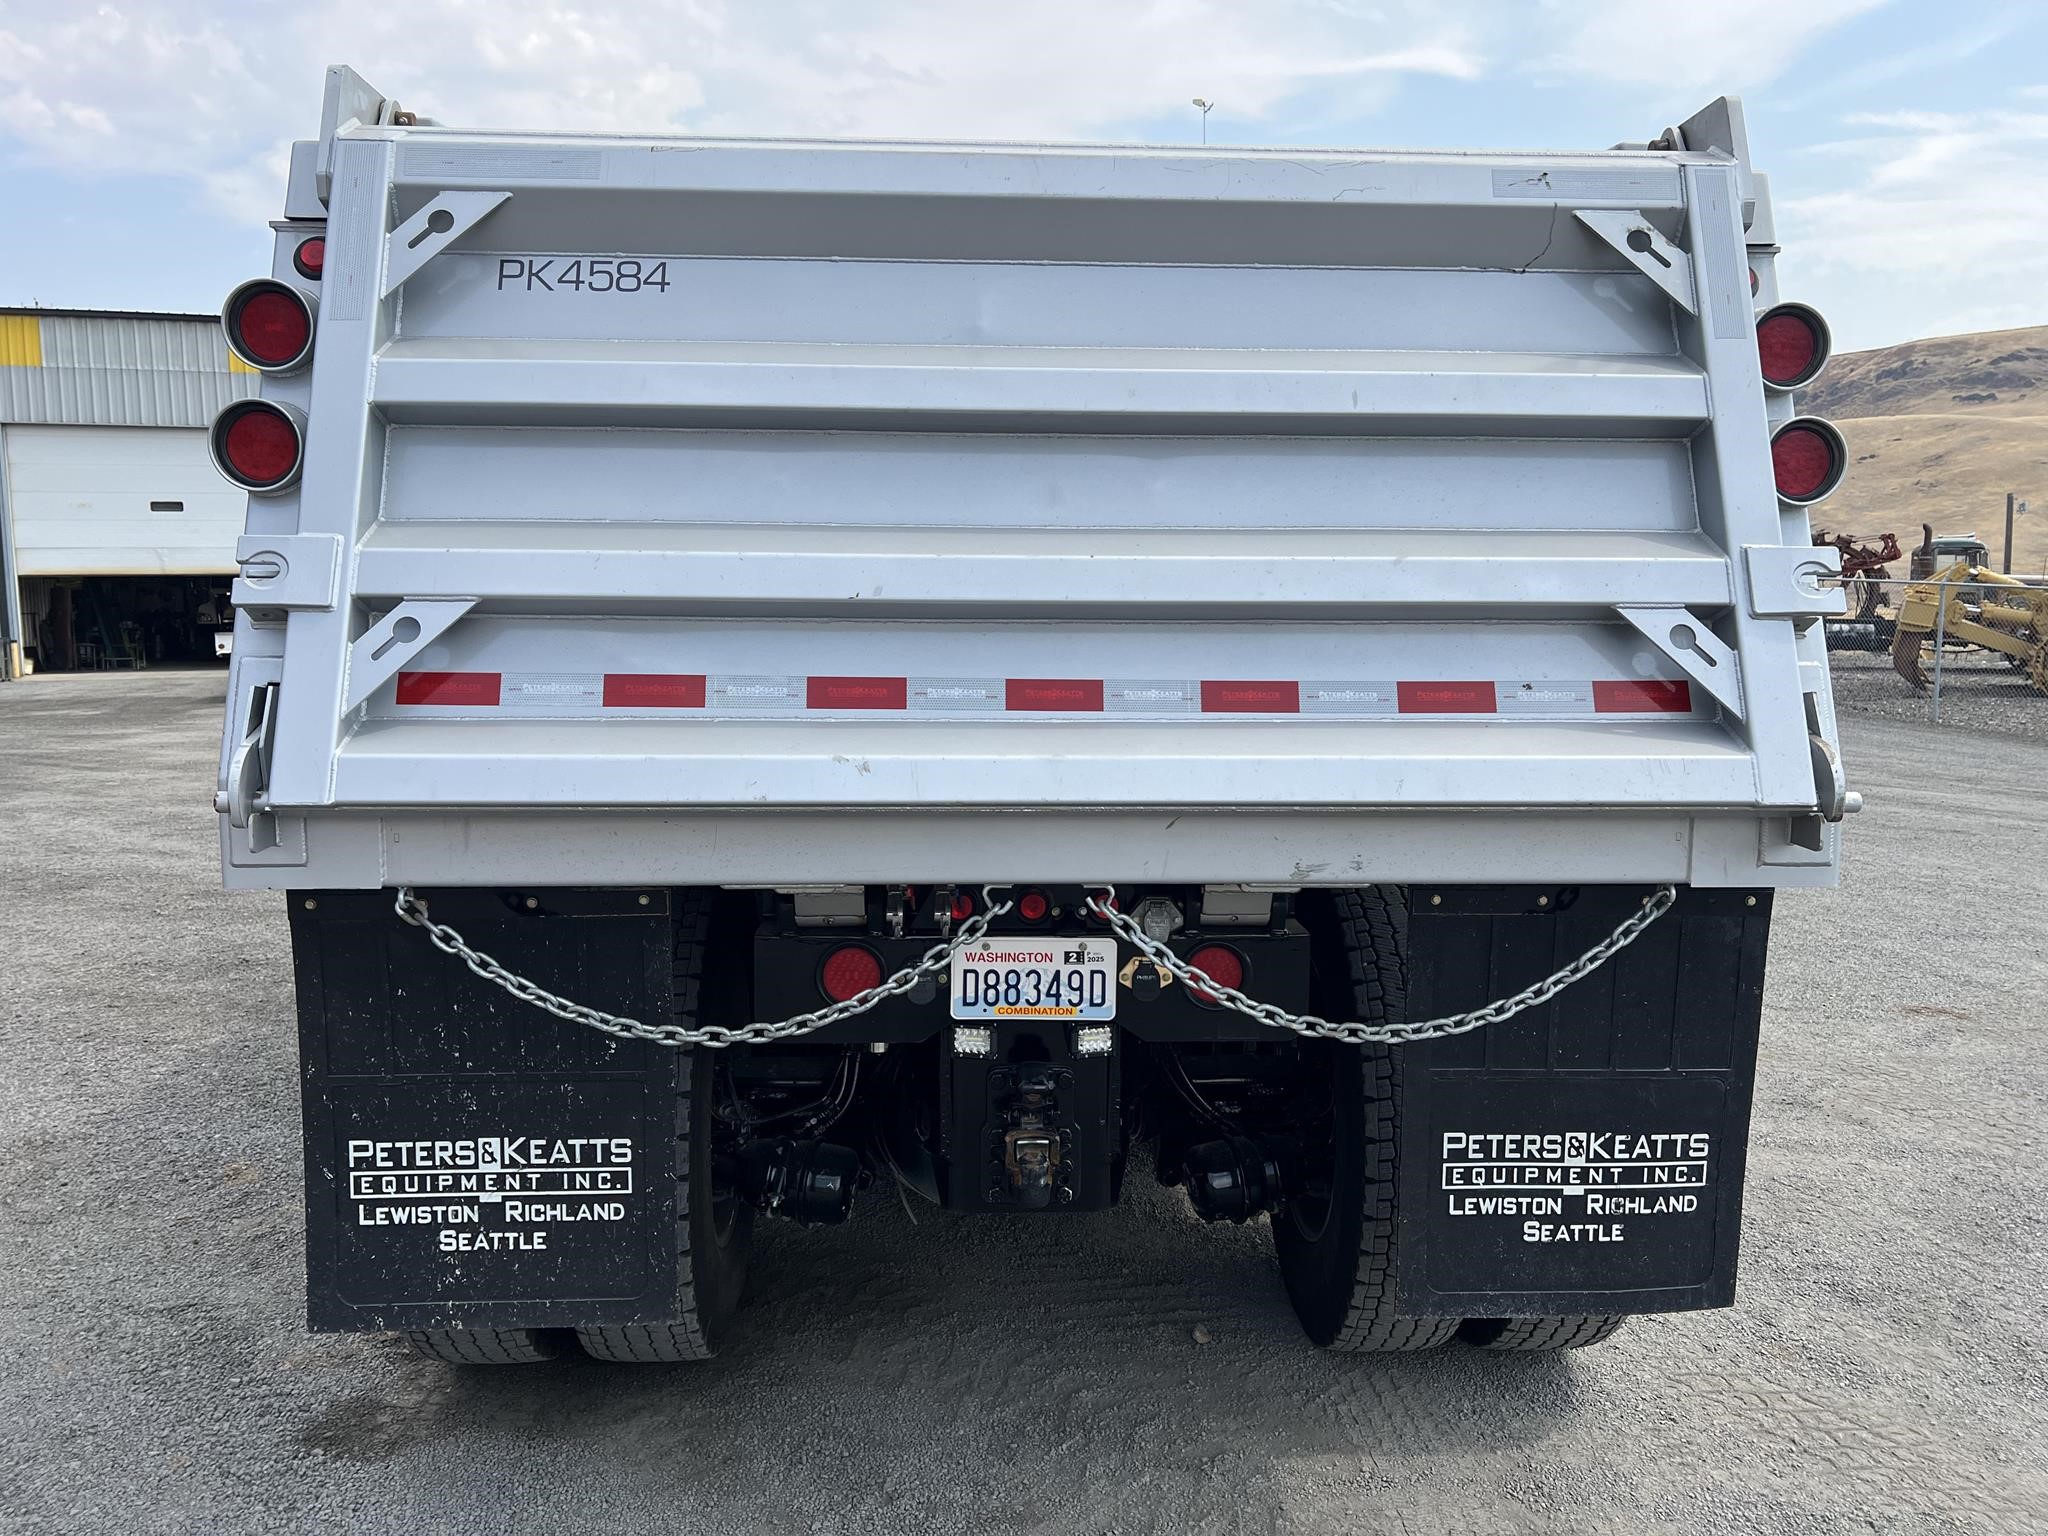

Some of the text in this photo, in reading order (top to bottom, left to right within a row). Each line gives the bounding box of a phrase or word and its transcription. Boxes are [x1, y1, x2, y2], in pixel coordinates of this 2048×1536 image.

[498, 259, 671, 293] PK4584
[965, 952, 1053, 963] WASHINGTON
[1069, 952, 1077, 963] 2
[1087, 955, 1105, 963] 2025
[962, 968, 1107, 1007] D88349D
[997, 1007, 1073, 1016] COMBINATION
[360, 1172, 622, 1195] EQUIPMENT INC.
[1452, 1166, 1697, 1187] EQUIPMENT INC.
[358, 1201, 625, 1225] LEWISTON RICHLAND
[1449, 1194, 1698, 1215] LEWISTON RICHLAND
[439, 1229, 547, 1251] SEATTLE
[1523, 1220, 1625, 1242] SEATTLE
